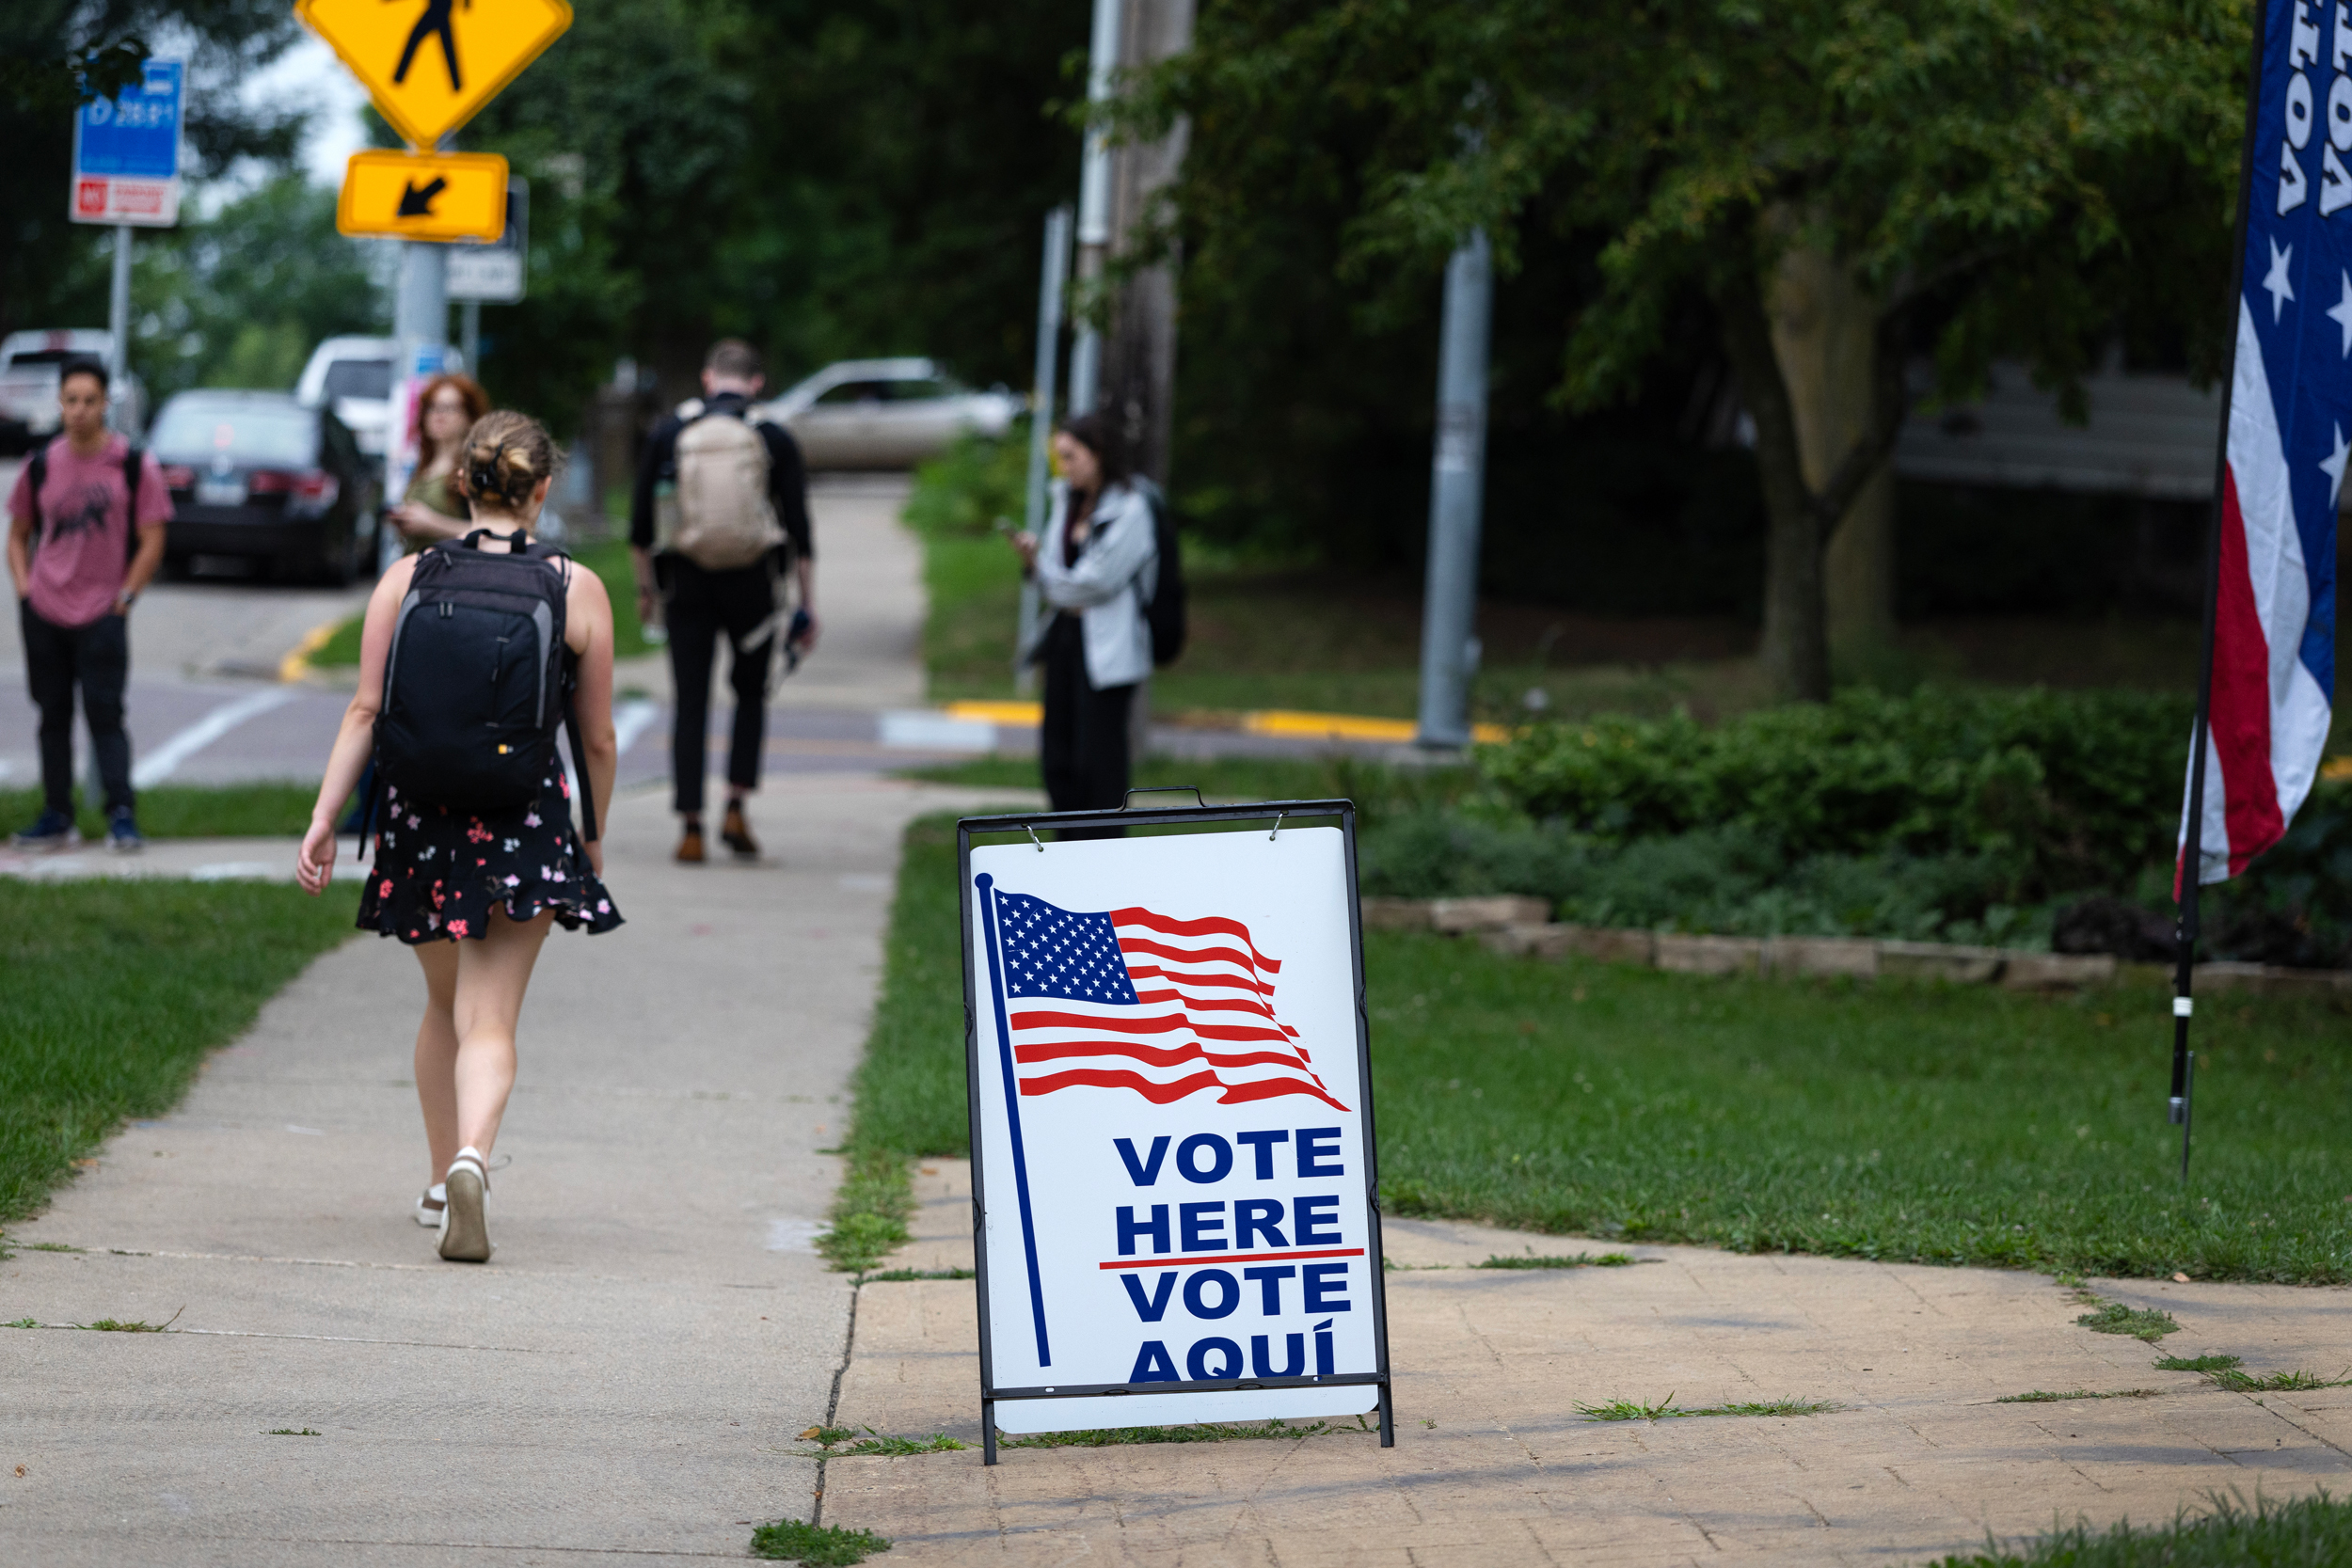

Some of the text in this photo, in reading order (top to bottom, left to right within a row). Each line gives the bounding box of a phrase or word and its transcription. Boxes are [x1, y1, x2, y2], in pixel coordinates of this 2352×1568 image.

[2276, 0, 2323, 216] VOT
[1113, 1127, 1344, 1187] VOTE
[1116, 1195, 1343, 1256] HERE
[1120, 1262, 1352, 1323] VOTE
[1128, 1317, 1335, 1383] AQUÍ
